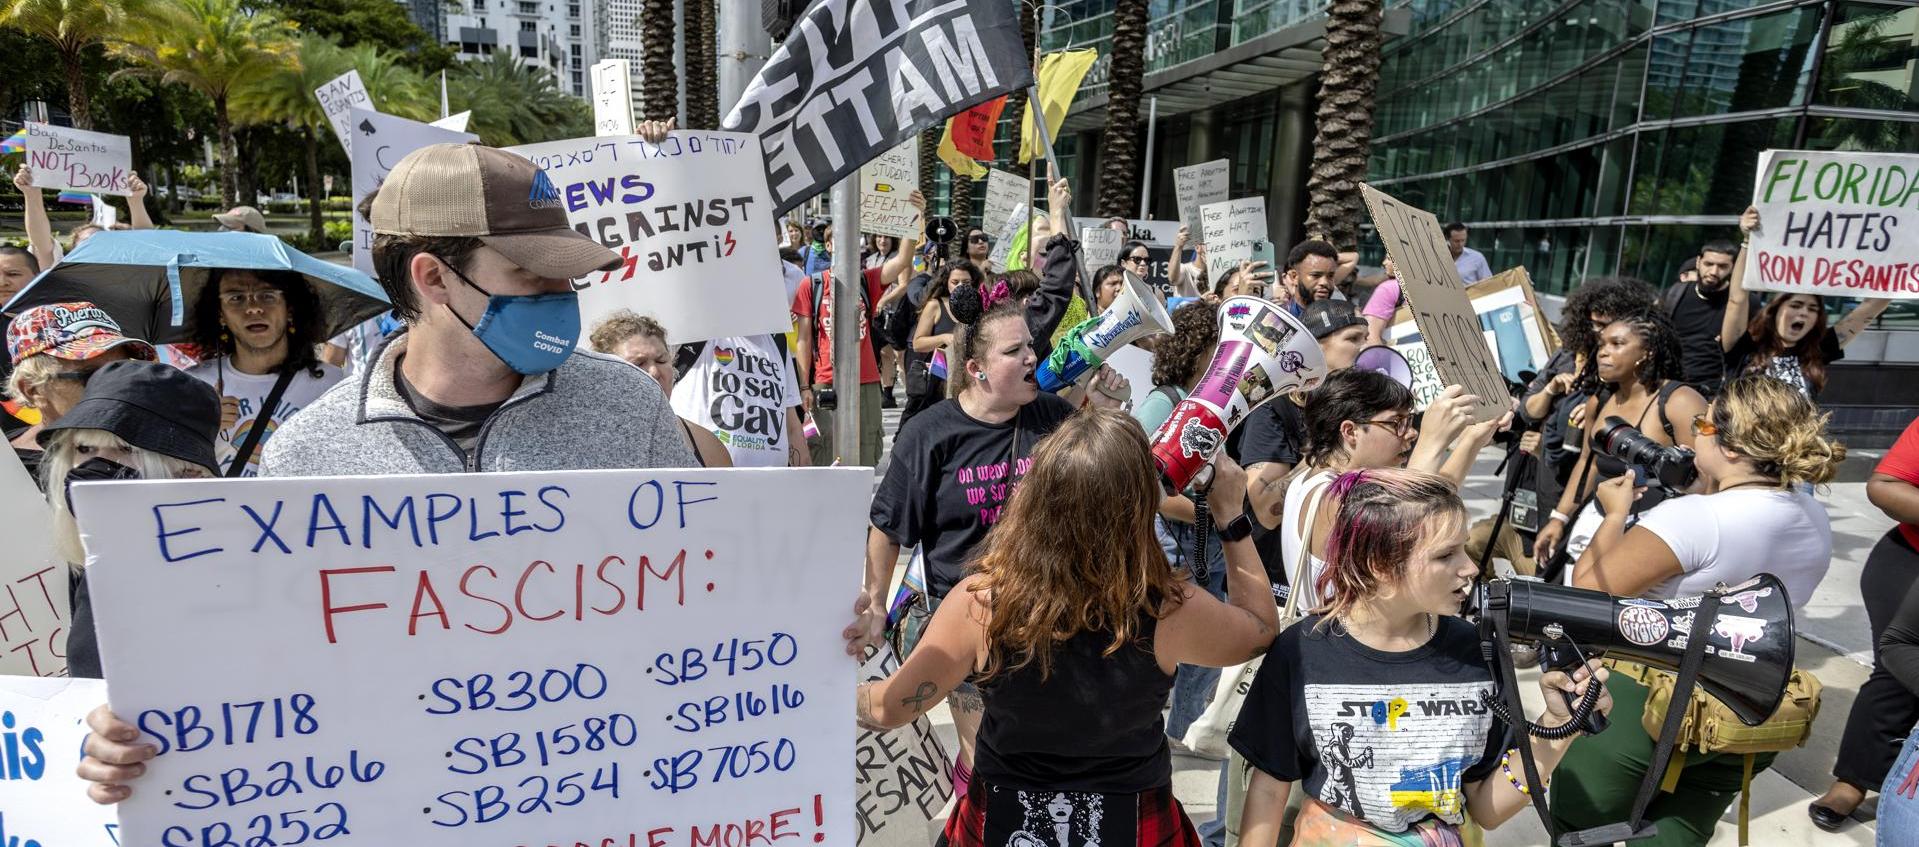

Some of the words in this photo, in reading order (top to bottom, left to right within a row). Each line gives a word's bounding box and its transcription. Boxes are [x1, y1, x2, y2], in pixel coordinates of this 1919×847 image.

[317, 75, 351, 104] BAN
[29, 123, 58, 137] Ban
[49, 137, 107, 153] DeSantis
[31, 150, 75, 171] NOT
[565, 174, 655, 214] EWS
[1202, 207, 1222, 222] FREE
[1204, 226, 1225, 240] FREE
[1782, 211, 1898, 252] HATES
[1205, 241, 1226, 254] FREE
[1382, 199, 1456, 290] FUCK
[1758, 251, 1805, 285] RON
[1812, 257, 1919, 293] DESANTIS
[54, 307, 102, 327] Puerto
[533, 341, 564, 355] COVID
[535, 330, 570, 347] Combat
[735, 346, 782, 382] free
[712, 368, 741, 394] to
[744, 376, 785, 408] say
[711, 393, 785, 446] Gay
[732, 434, 767, 445] EQUALITY
[732, 441, 766, 451] FLORIDA
[153, 485, 570, 563] EXAMPLES
[628, 480, 718, 530] OF
[318, 548, 715, 643] FASCISM:
[1622, 621, 1667, 643] CHOICE
[1417, 700, 1488, 717] WARS
[137, 693, 319, 757] SB1718
[161, 802, 351, 847] SB252
